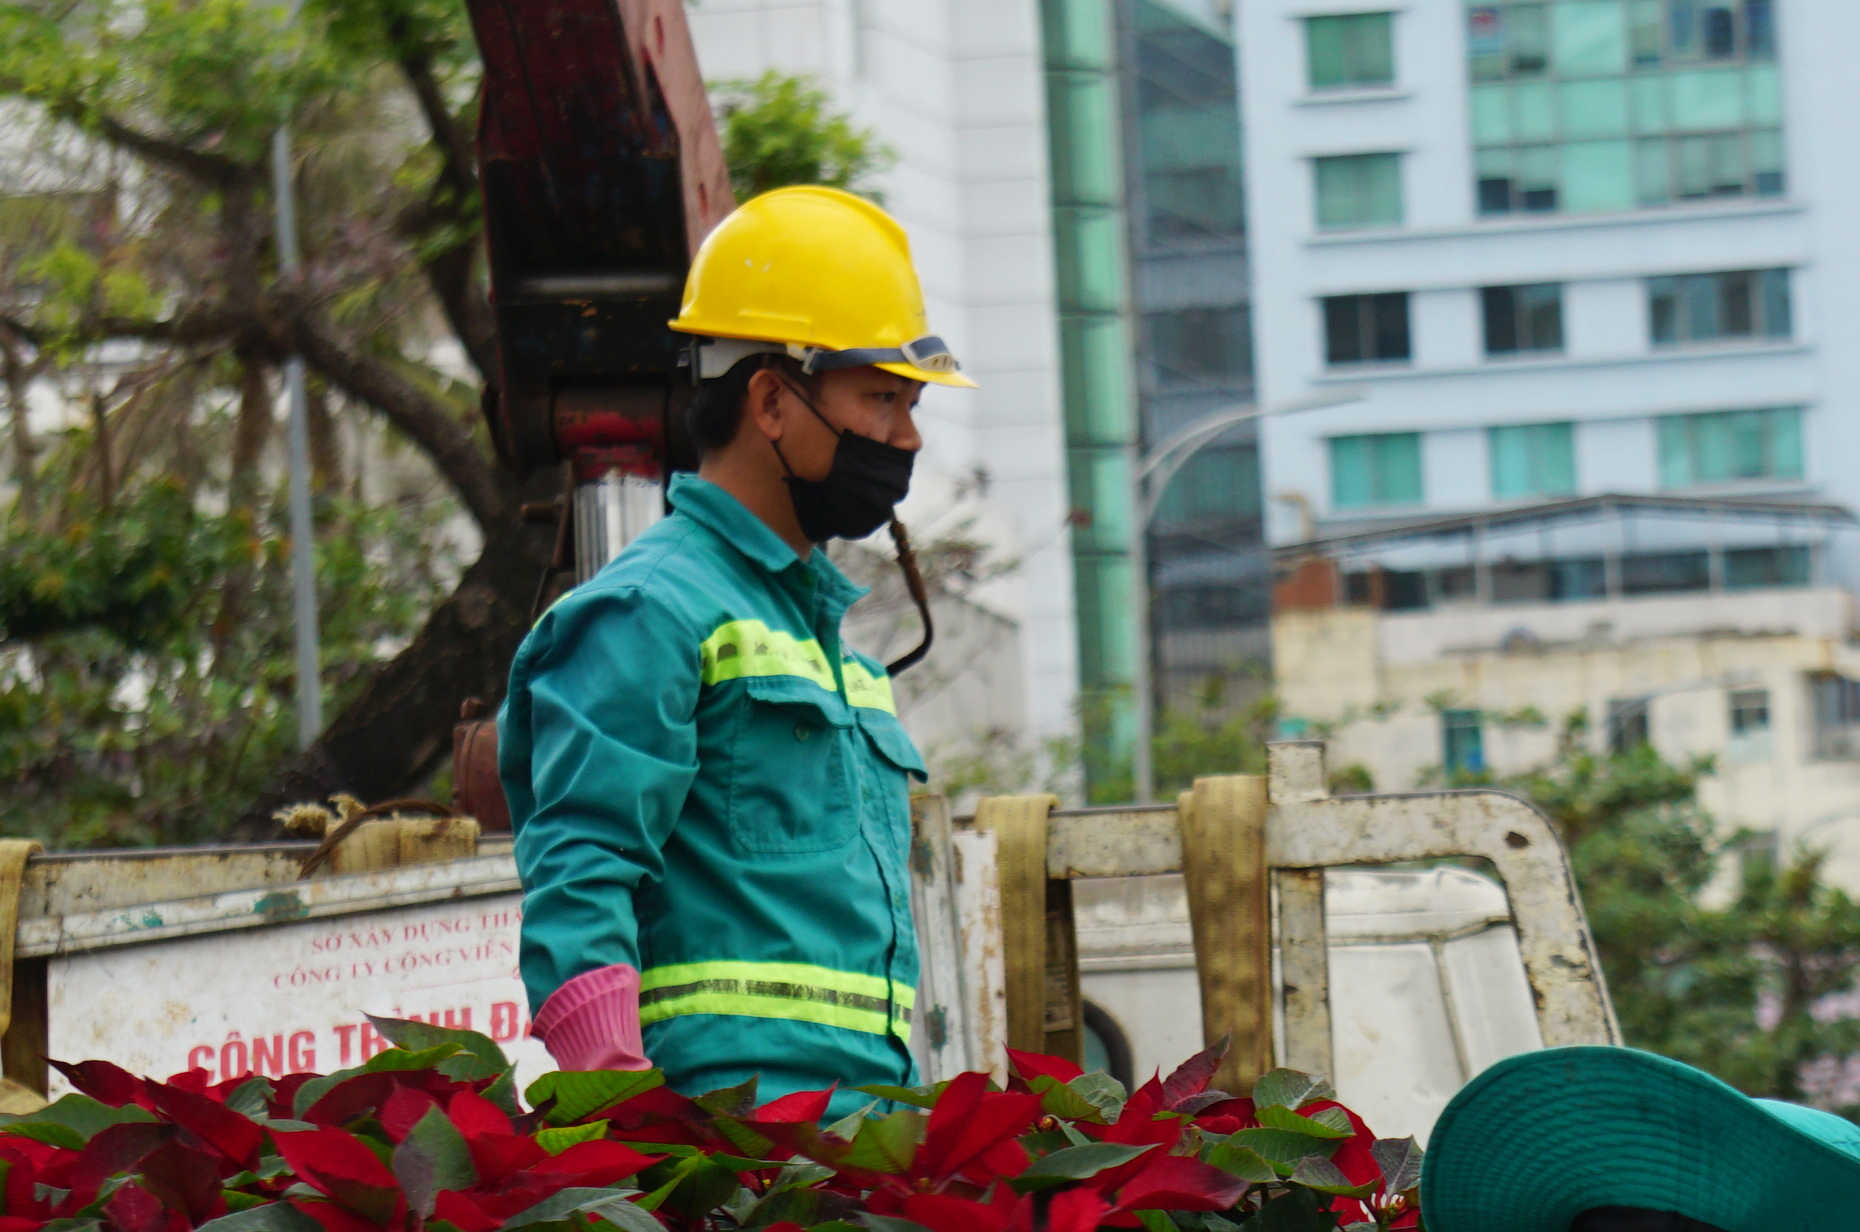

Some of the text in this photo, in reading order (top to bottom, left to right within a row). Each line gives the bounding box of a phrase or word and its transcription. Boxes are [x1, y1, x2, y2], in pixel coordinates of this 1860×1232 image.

[273, 937, 514, 990] CÔNG TY CÔNG VIÊN
